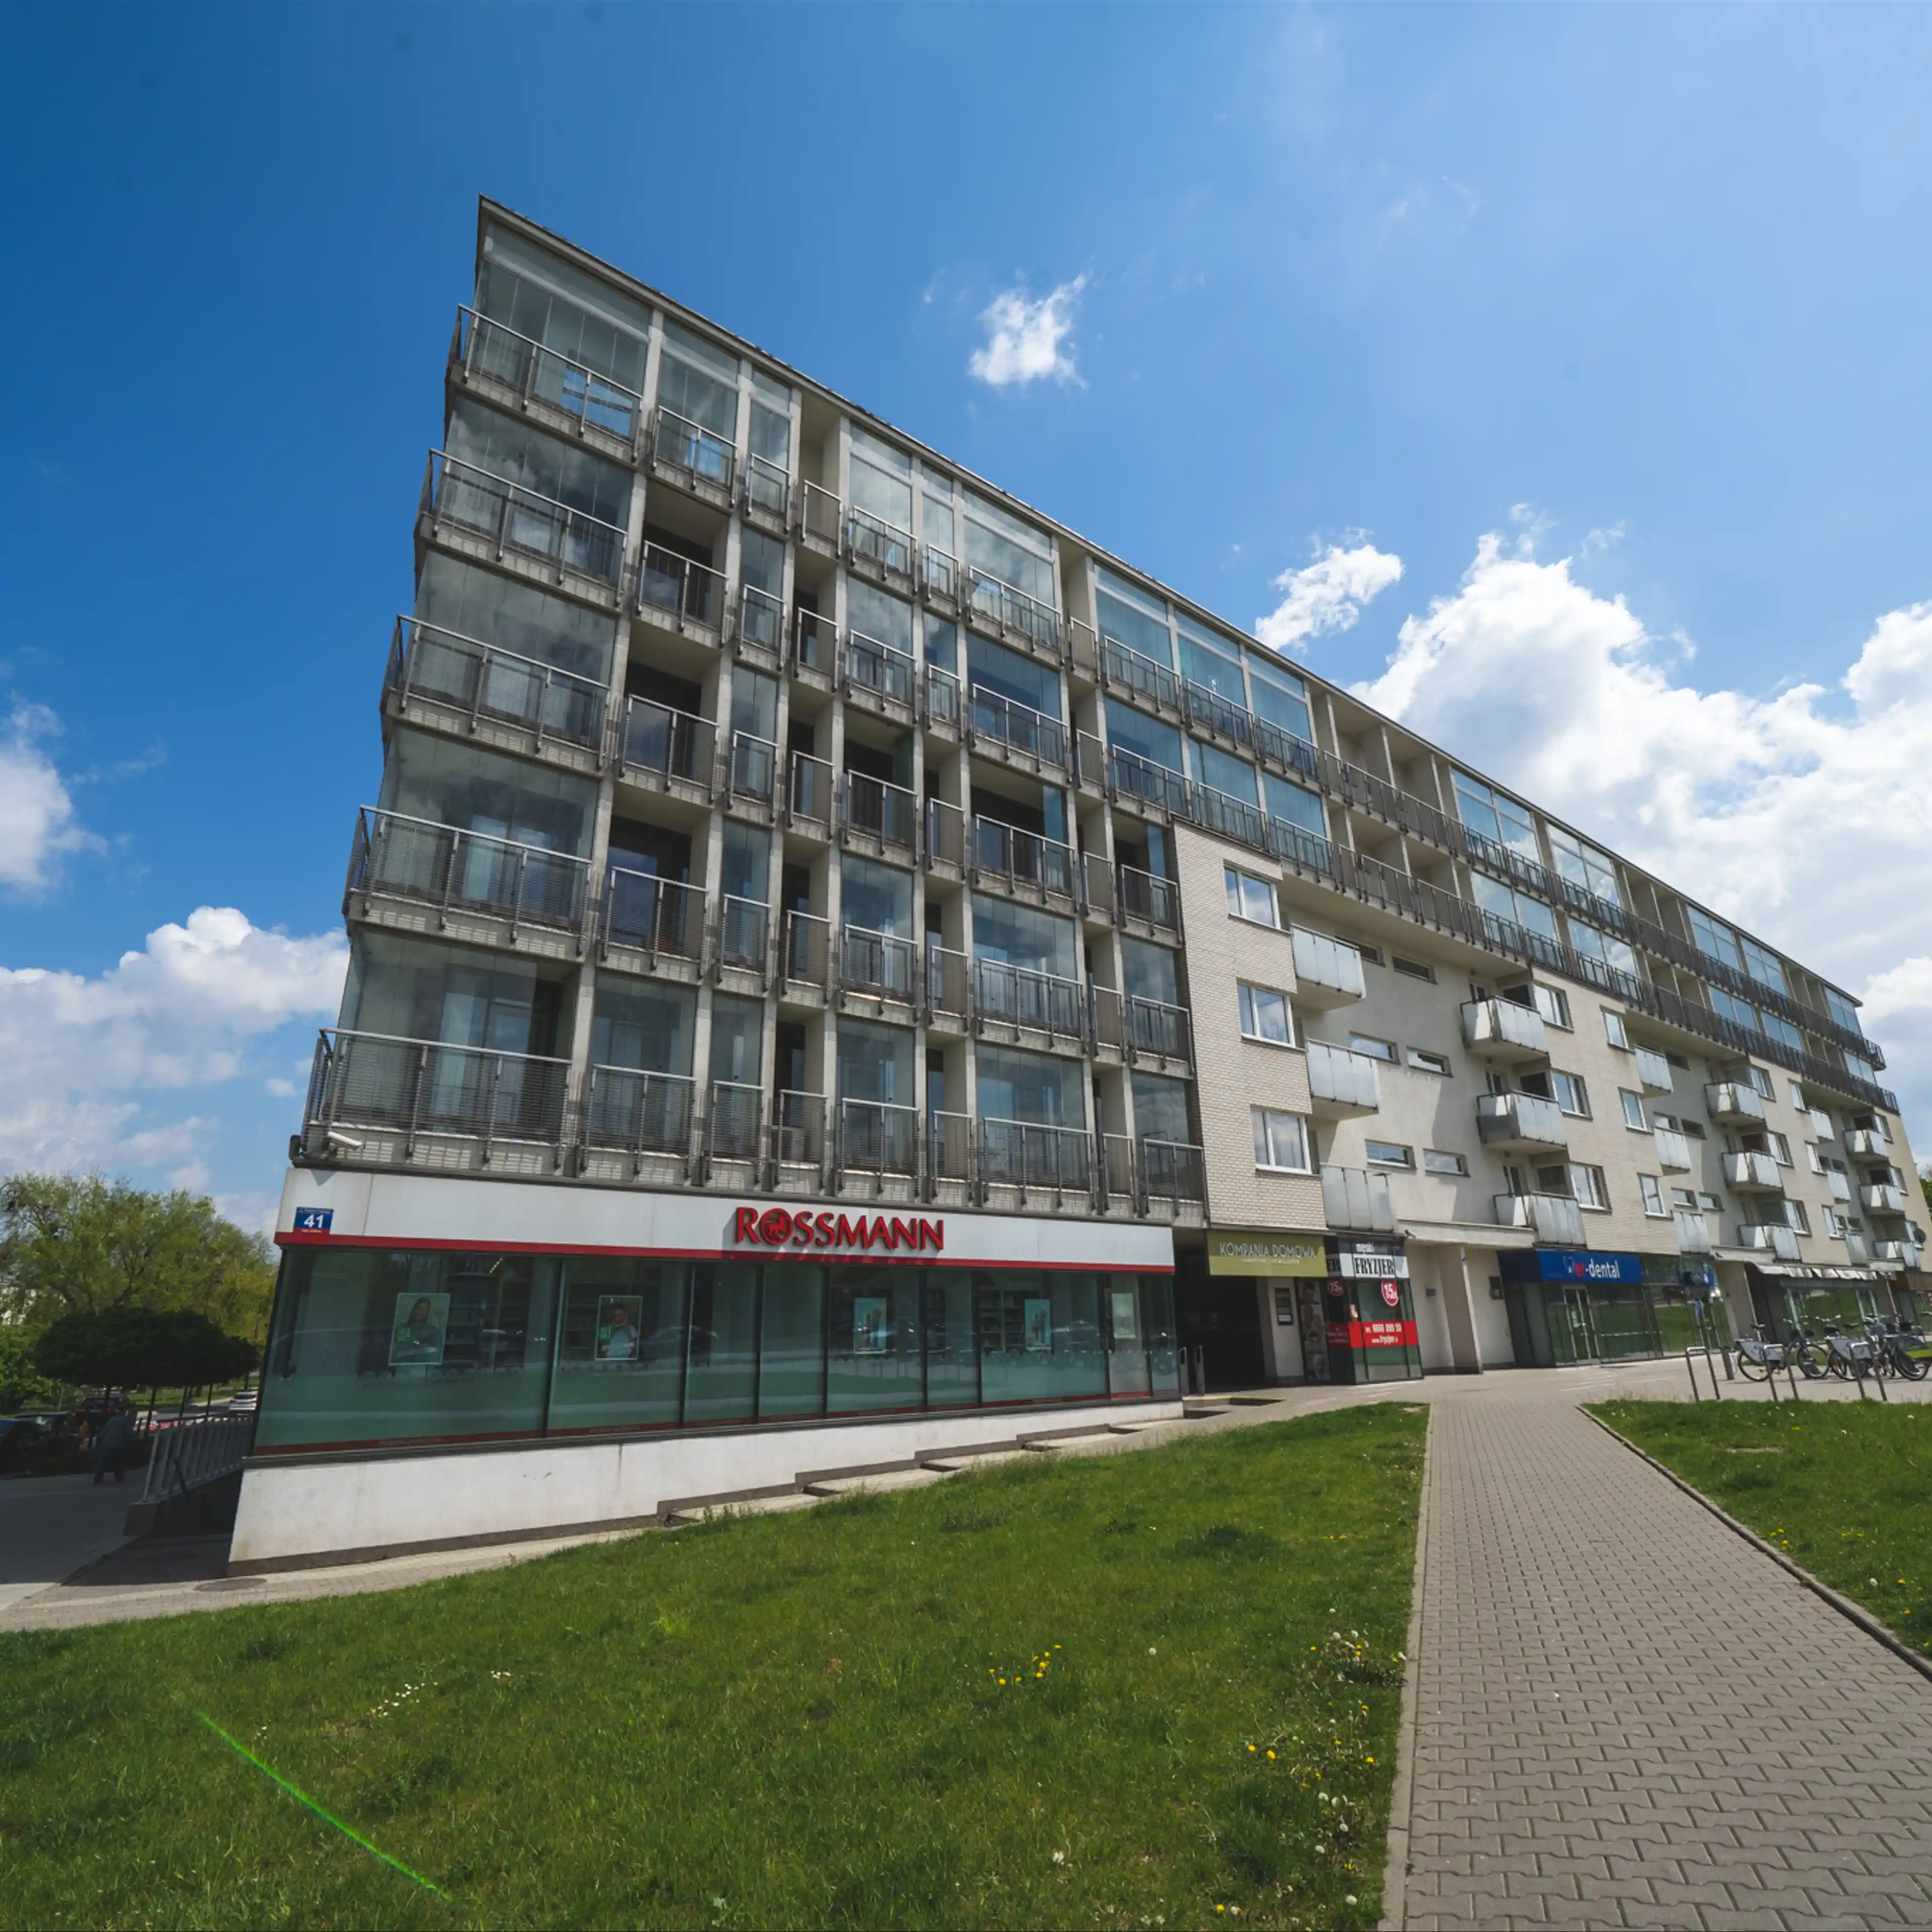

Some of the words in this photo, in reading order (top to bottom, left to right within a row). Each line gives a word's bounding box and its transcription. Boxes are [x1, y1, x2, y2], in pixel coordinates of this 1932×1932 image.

[304, 1214, 324, 1228] 41
[736, 1206, 944, 1250] ROSSMANN
[1220, 1242, 1270, 1257] KOMPANIA
[1272, 1244, 1317, 1258] DOMOWA
[1354, 1257, 1395, 1276] FRYZJER
